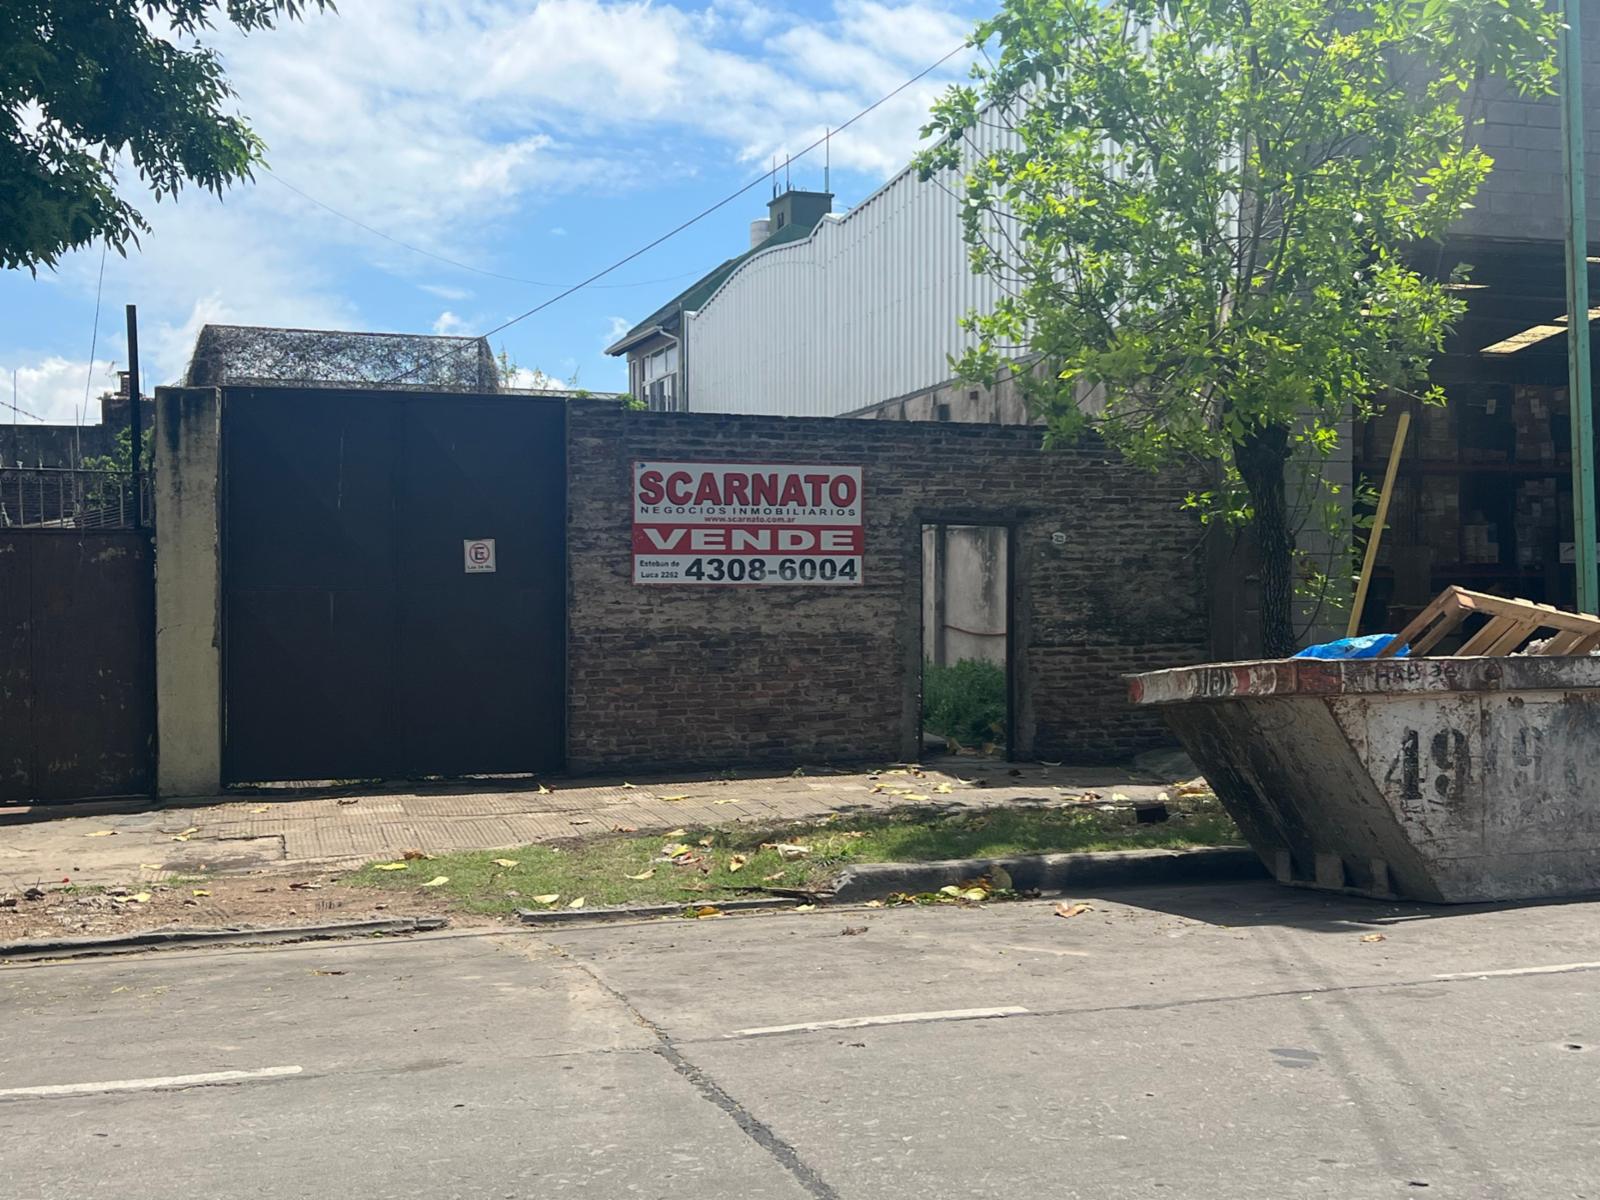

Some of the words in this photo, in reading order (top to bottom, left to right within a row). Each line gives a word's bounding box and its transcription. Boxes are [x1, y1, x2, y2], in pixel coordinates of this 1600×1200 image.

[638, 470, 857, 507] SCARNATO
[640, 506, 727, 515] NEGOCIOS
[732, 507, 856, 517] INMOBILIARIOS
[704, 516, 796, 524] www.scarnato.com.ar
[643, 528, 855, 551] VENDE
[670, 560, 680, 568] de
[684, 557, 857, 581] 4308-6004
[641, 571, 659, 579] Luca
